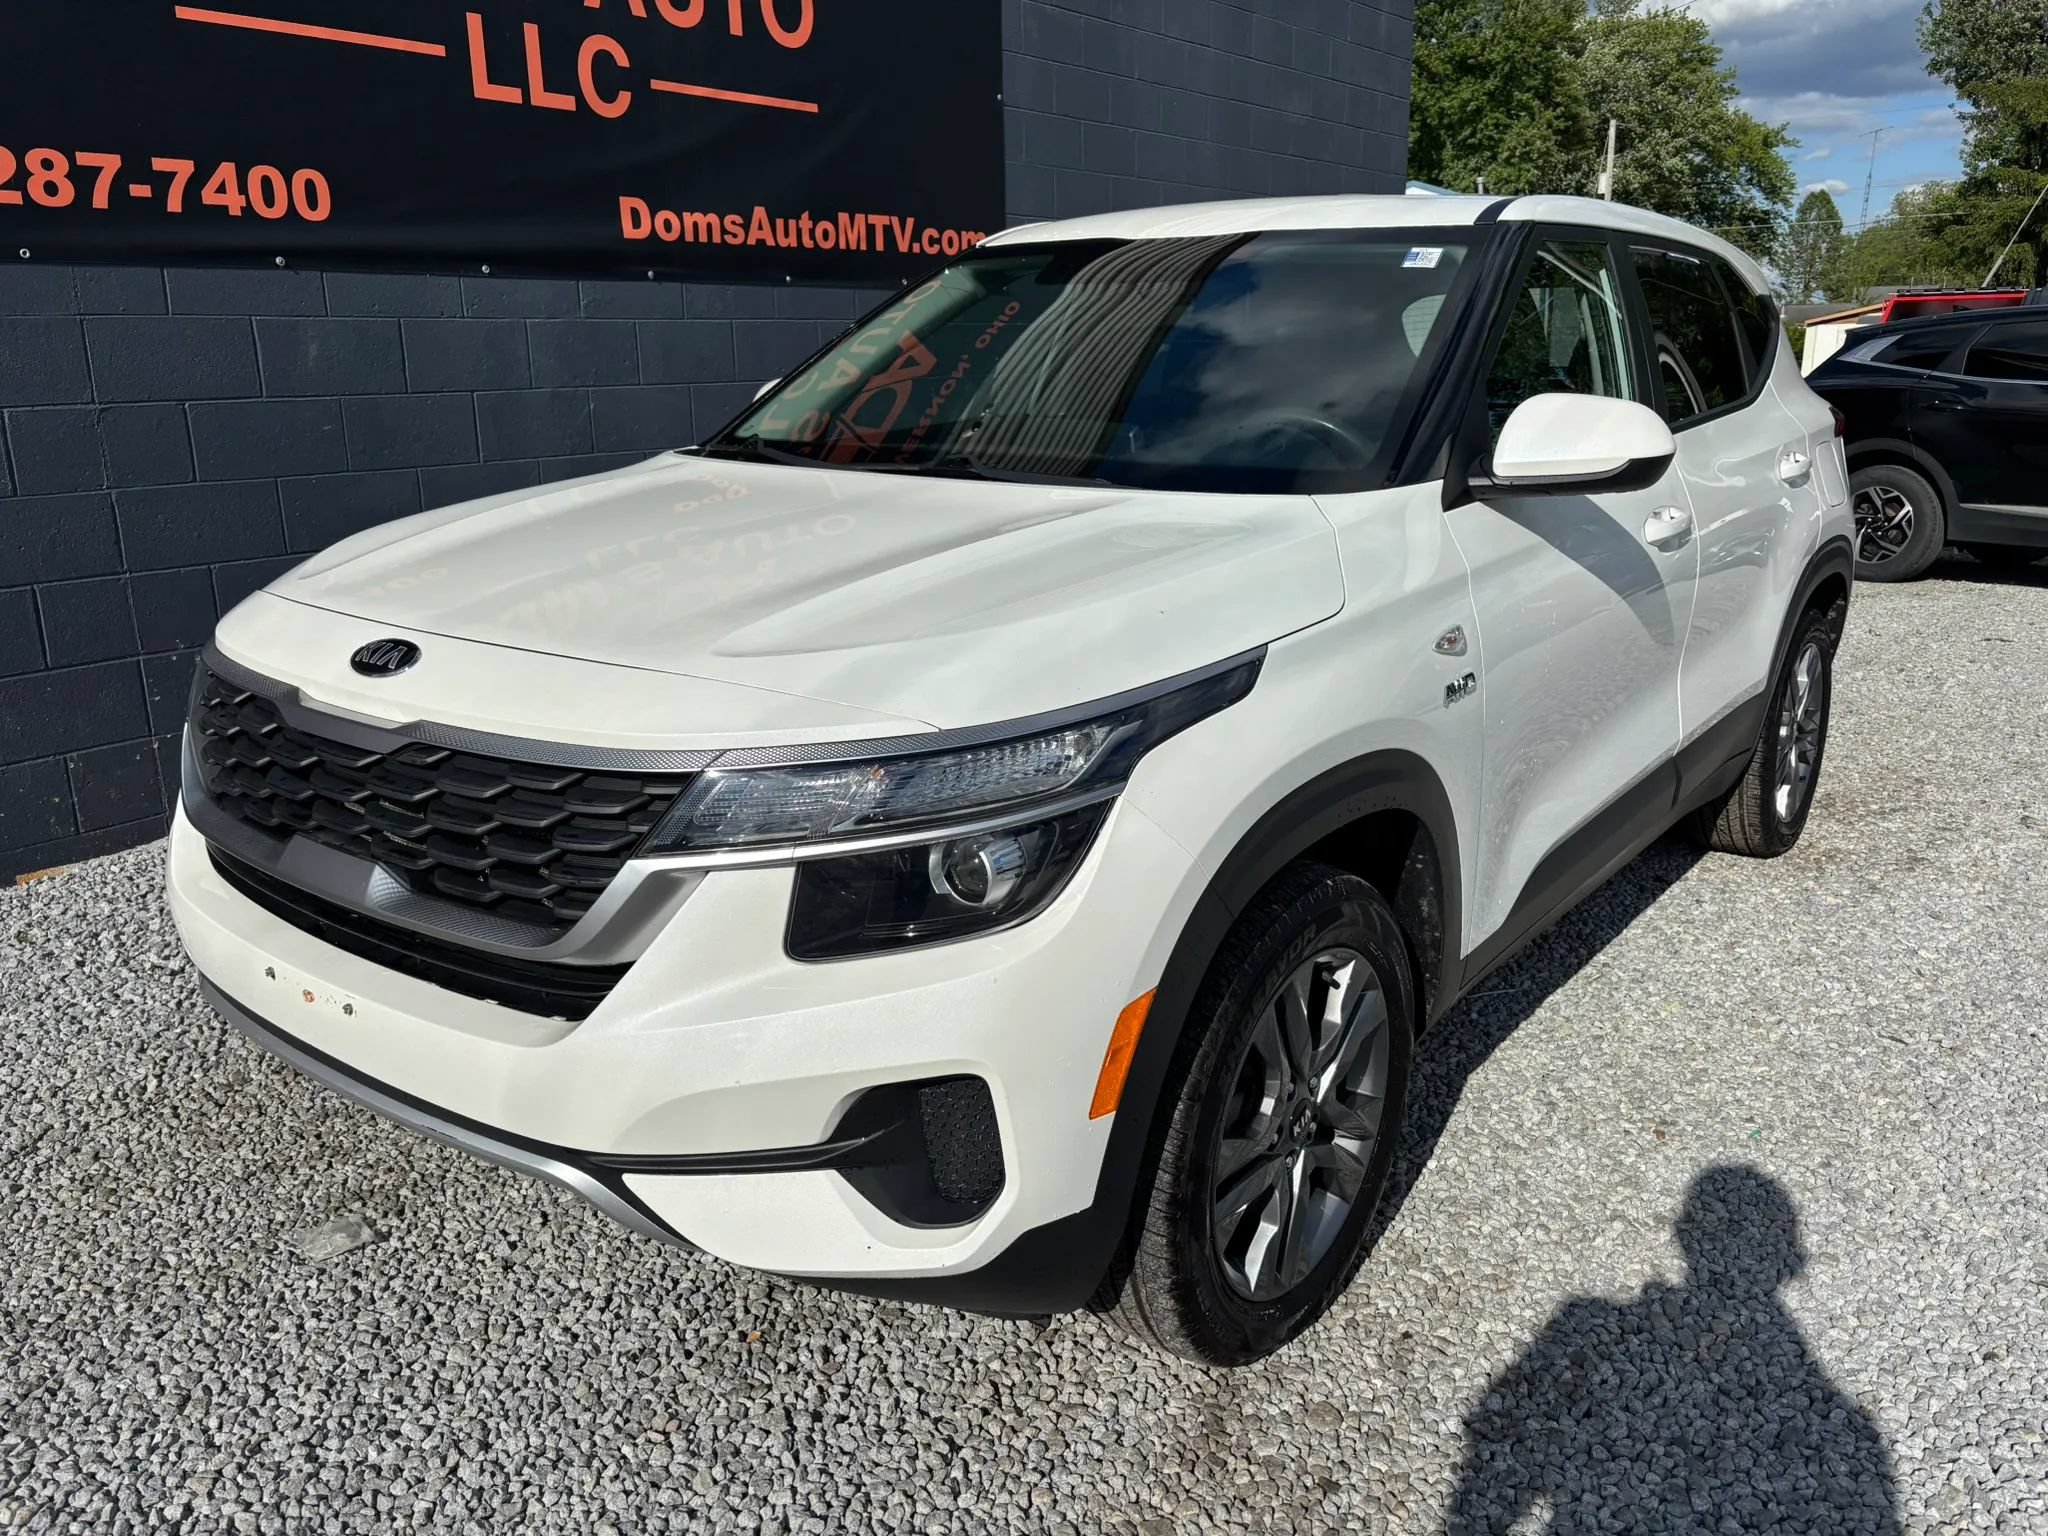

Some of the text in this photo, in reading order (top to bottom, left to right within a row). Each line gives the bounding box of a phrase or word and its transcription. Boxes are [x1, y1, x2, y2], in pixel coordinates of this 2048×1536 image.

[466, 12, 632, 118] LLC
[618, 196, 987, 256] DomsAutoMTV.com
[354, 641, 408, 669] KIA
[1444, 671, 1477, 704] AWD
